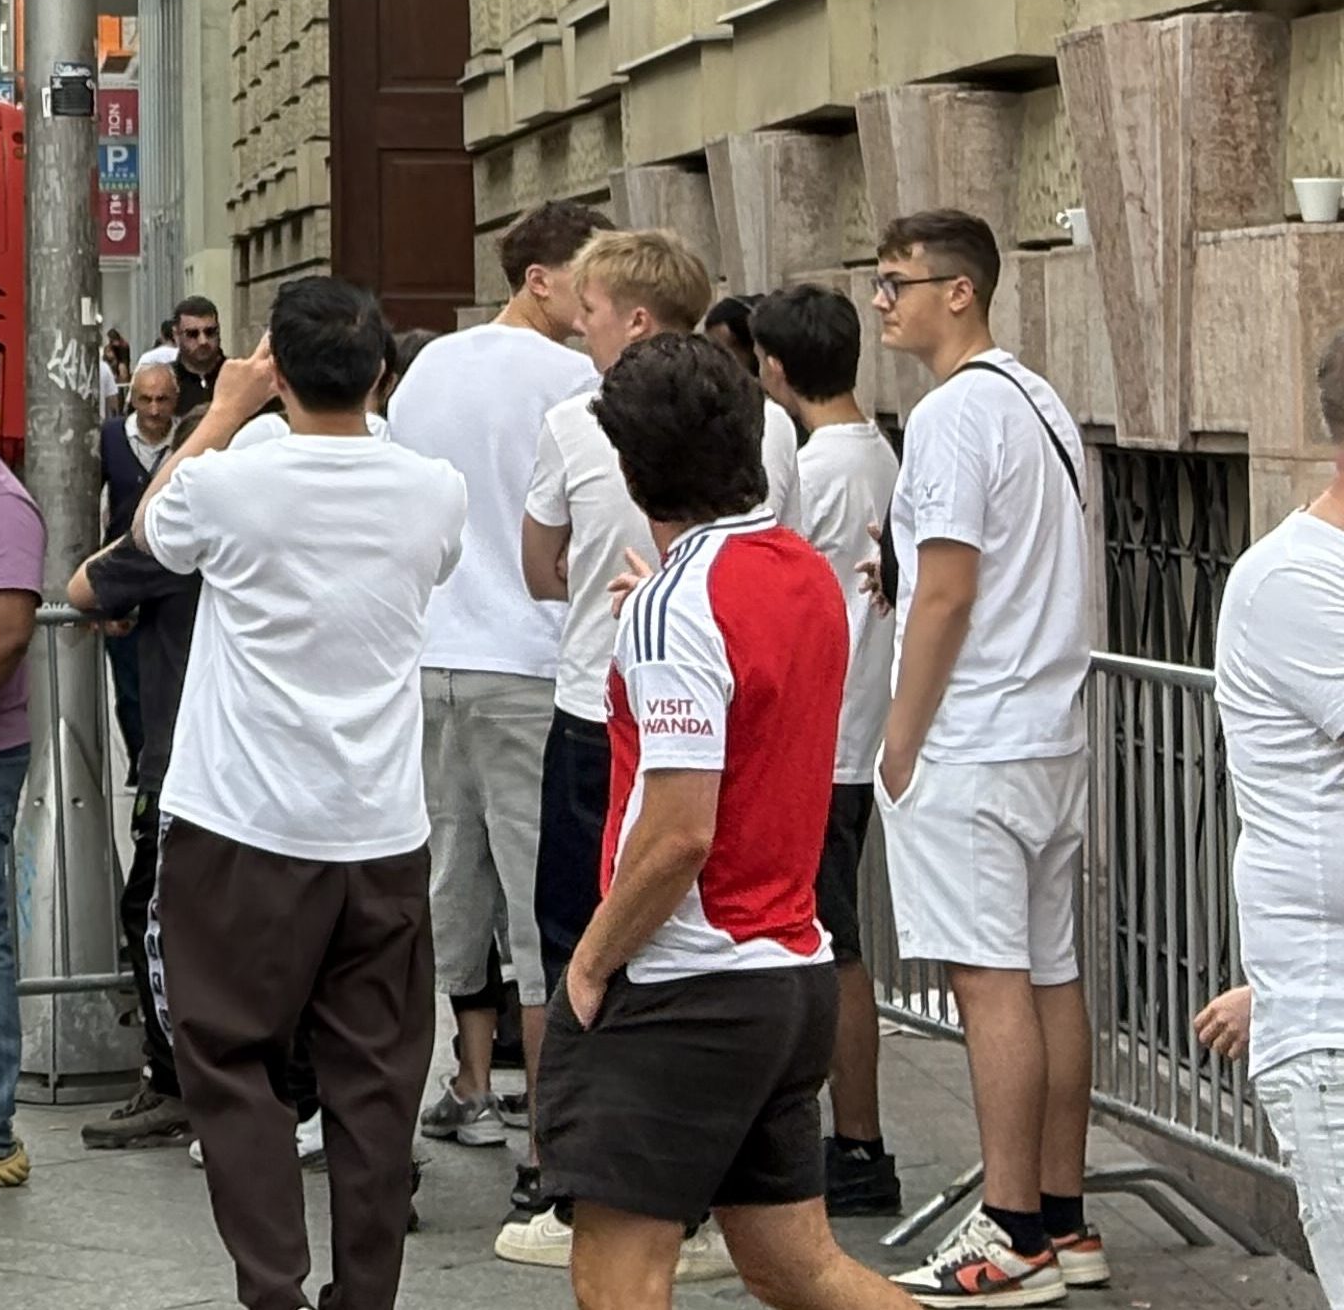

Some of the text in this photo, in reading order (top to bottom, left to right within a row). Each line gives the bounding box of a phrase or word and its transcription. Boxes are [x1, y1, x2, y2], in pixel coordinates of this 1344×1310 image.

[107, 146, 129, 173] P
[646, 698, 693, 715] VISIT
[642, 718, 714, 736] WANDA
